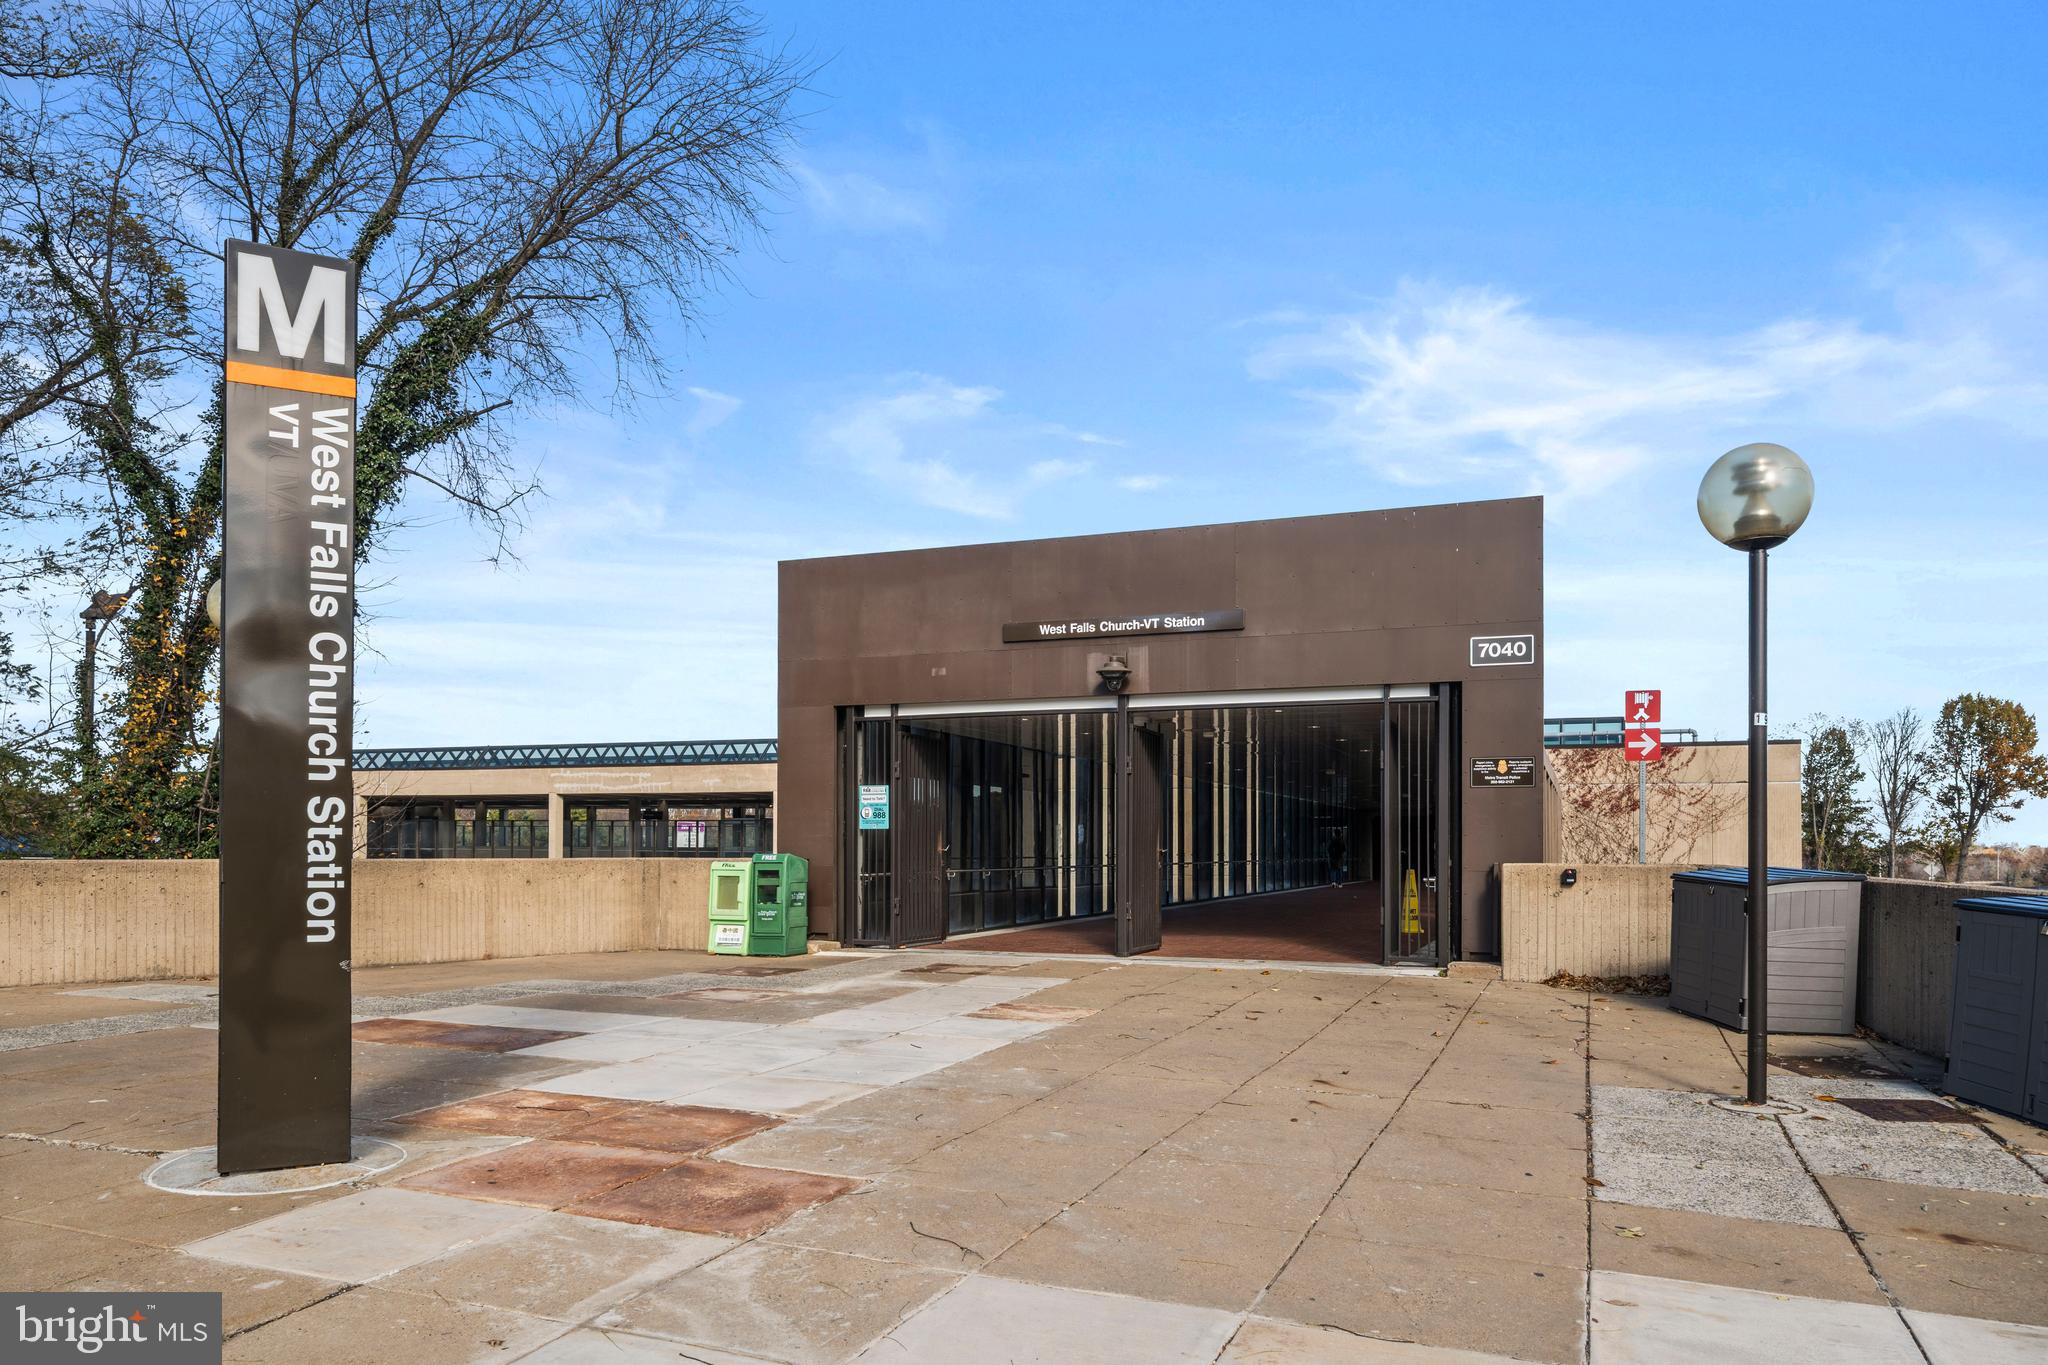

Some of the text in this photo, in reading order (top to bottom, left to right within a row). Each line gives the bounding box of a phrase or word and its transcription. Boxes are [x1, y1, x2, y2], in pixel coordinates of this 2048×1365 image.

[237, 251, 347, 365] M
[268, 403, 300, 448] VT
[1039, 616, 1205, 635] West Falls Church-VT Station
[1478, 641, 1527, 658] 7040
[306, 407, 350, 944] West Falls Church Station
